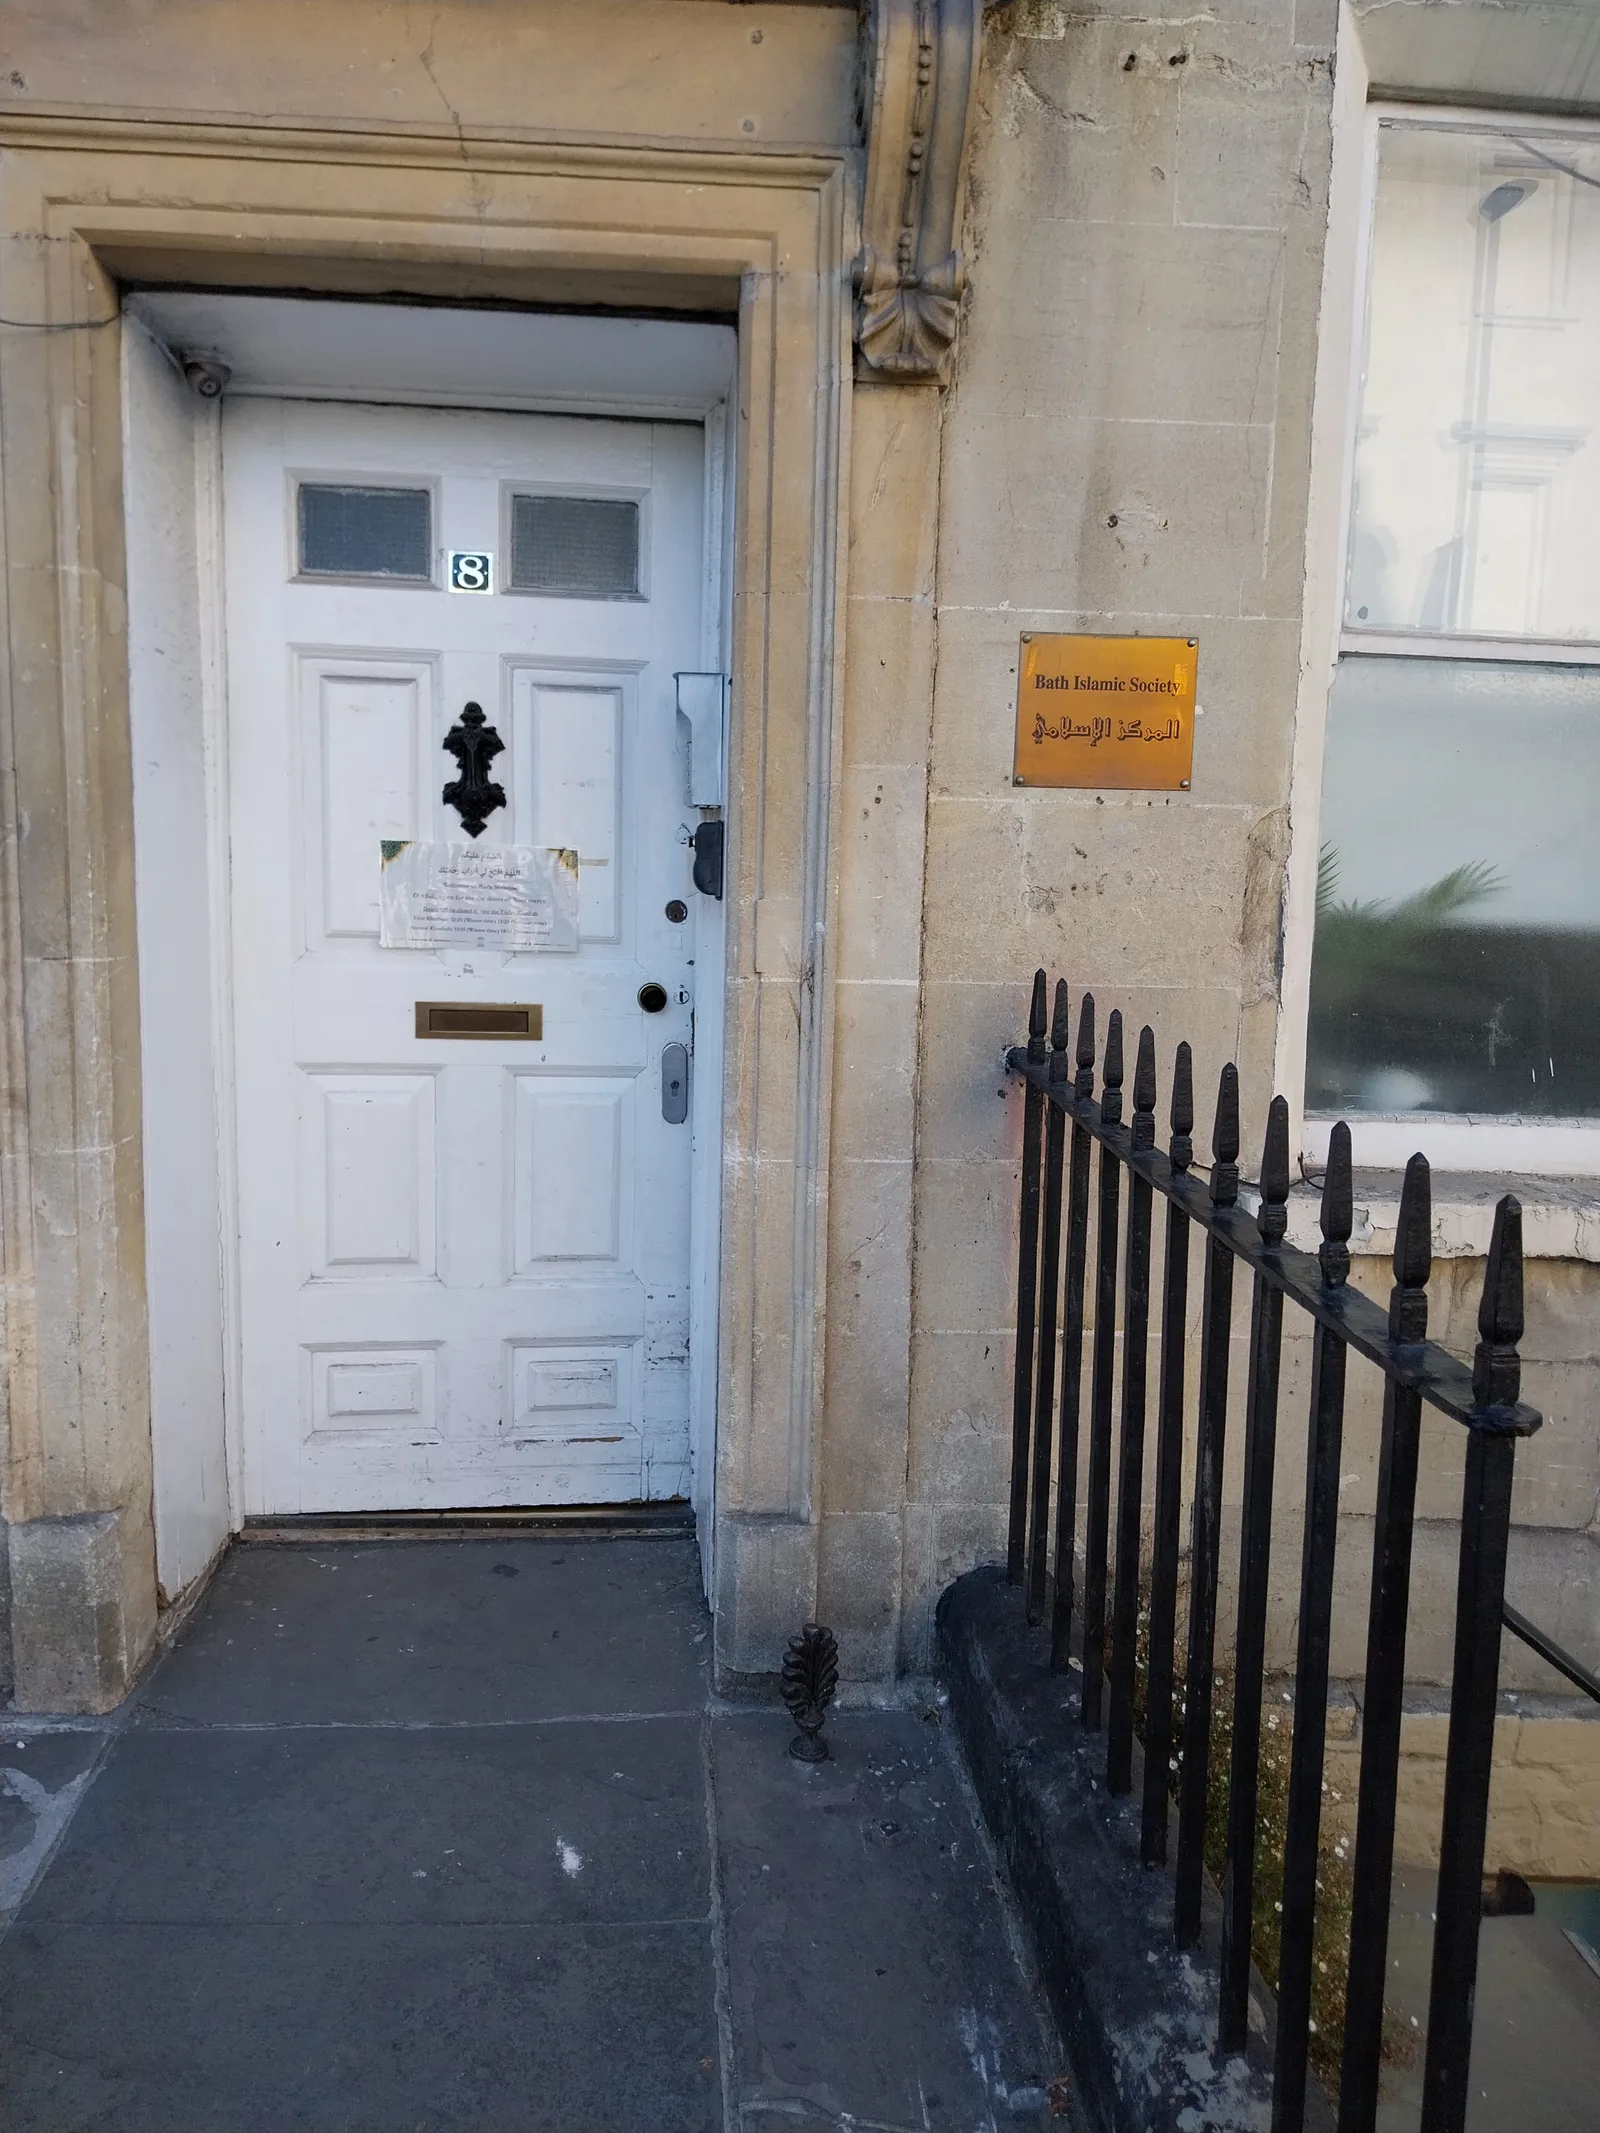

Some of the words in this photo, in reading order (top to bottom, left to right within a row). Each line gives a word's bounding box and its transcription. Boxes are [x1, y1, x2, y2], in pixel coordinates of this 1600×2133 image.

[457, 556, 484, 589] 8
[1034, 674, 1069, 690] Bath
[1073, 675, 1126, 692] Islamic
[1129, 677, 1181, 697] Society
[1032, 712, 1111, 747] الإسلامي
[1117, 718, 1180, 742] المركز
